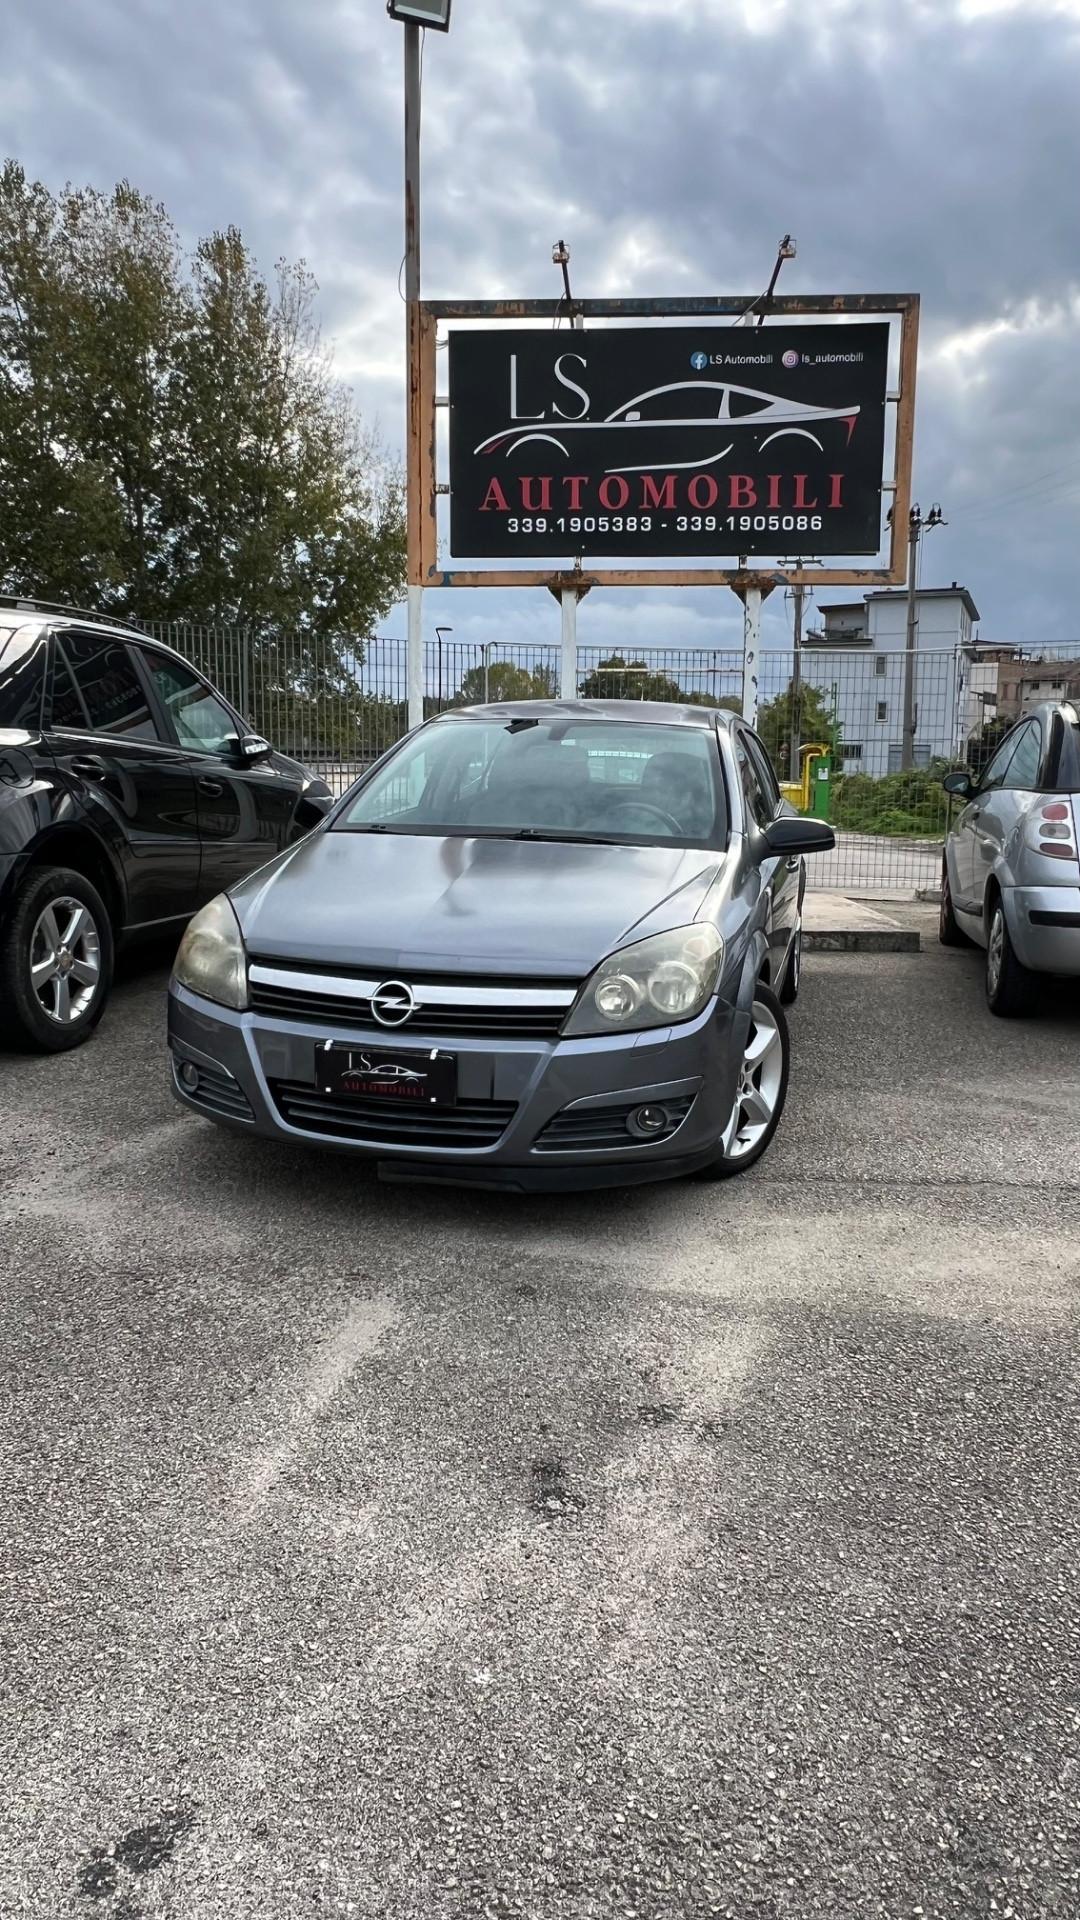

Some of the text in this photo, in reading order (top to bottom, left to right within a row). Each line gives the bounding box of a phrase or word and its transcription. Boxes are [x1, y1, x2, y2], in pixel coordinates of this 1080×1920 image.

[709, 354, 773, 365] LS Automobili
[801, 352, 864, 366] ls_automobili
[510, 353, 590, 420] LS
[478, 474, 845, 511] AUTOMOBILI
[507, 517, 652, 533] 339.1905383
[676, 515, 822, 531] 339.1905086
